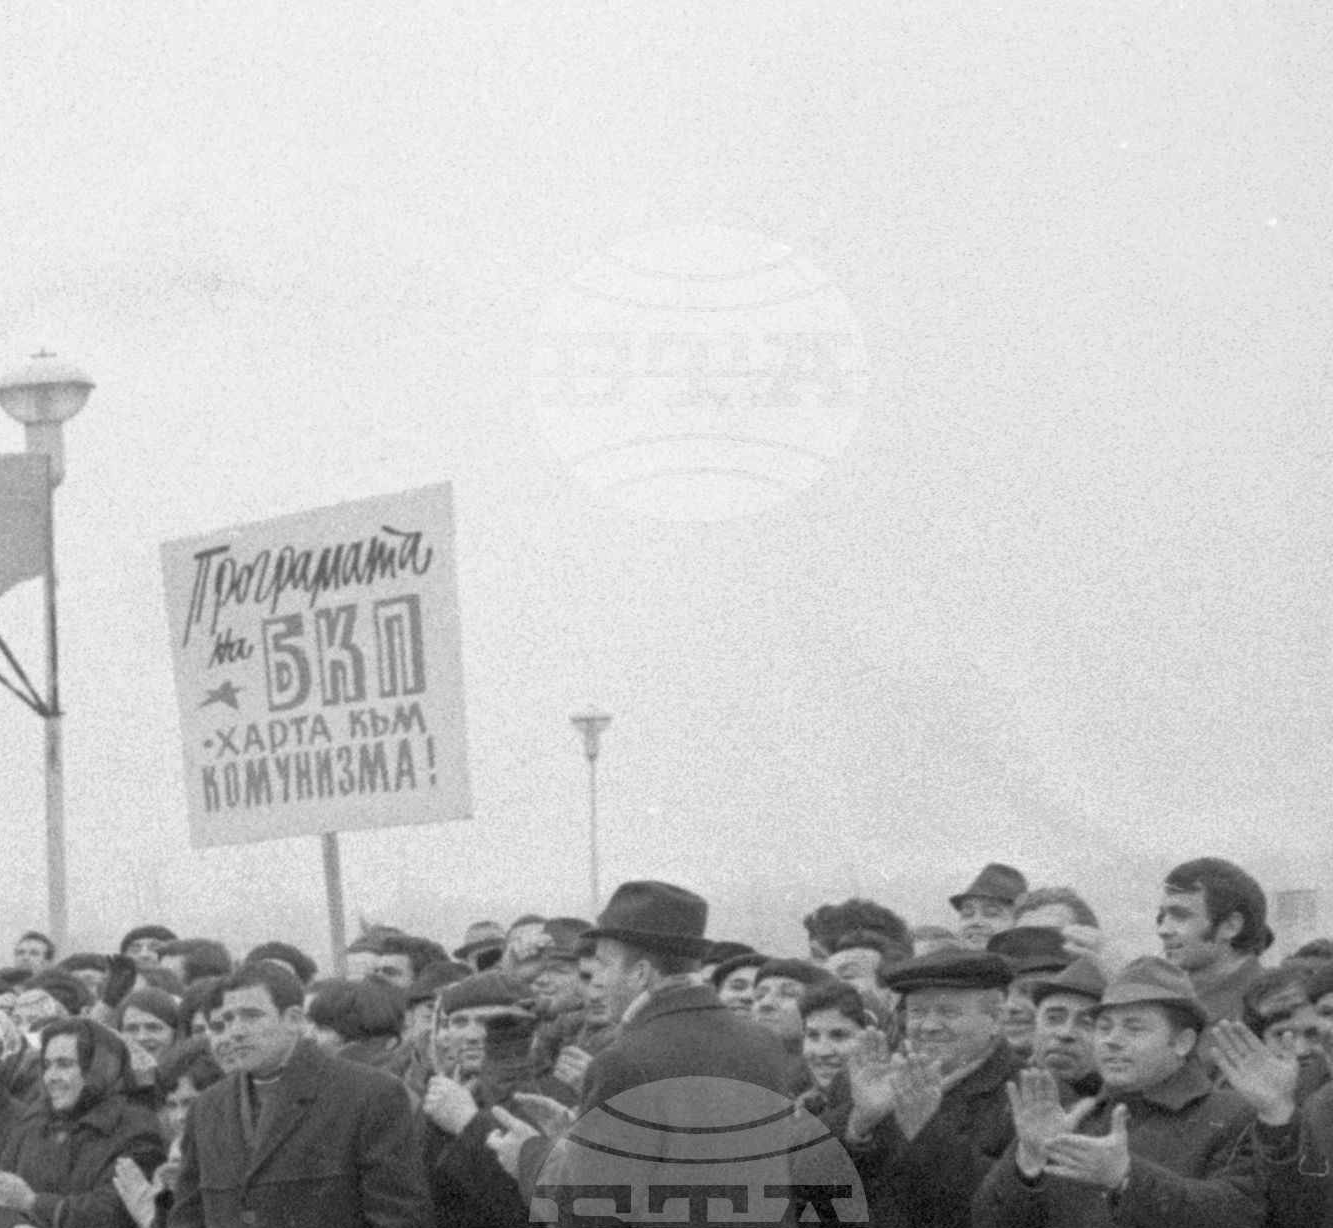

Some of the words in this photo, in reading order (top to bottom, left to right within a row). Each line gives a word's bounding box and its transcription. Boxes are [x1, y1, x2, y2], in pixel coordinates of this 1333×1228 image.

[183, 525, 433, 648] Програмата
[261, 594, 426, 712] БКП
[201, 735, 436, 813] КОМУНИЗМА!
[216, 714, 332, 760] ХАРТА
[349, 702, 427, 740] КЪМ
